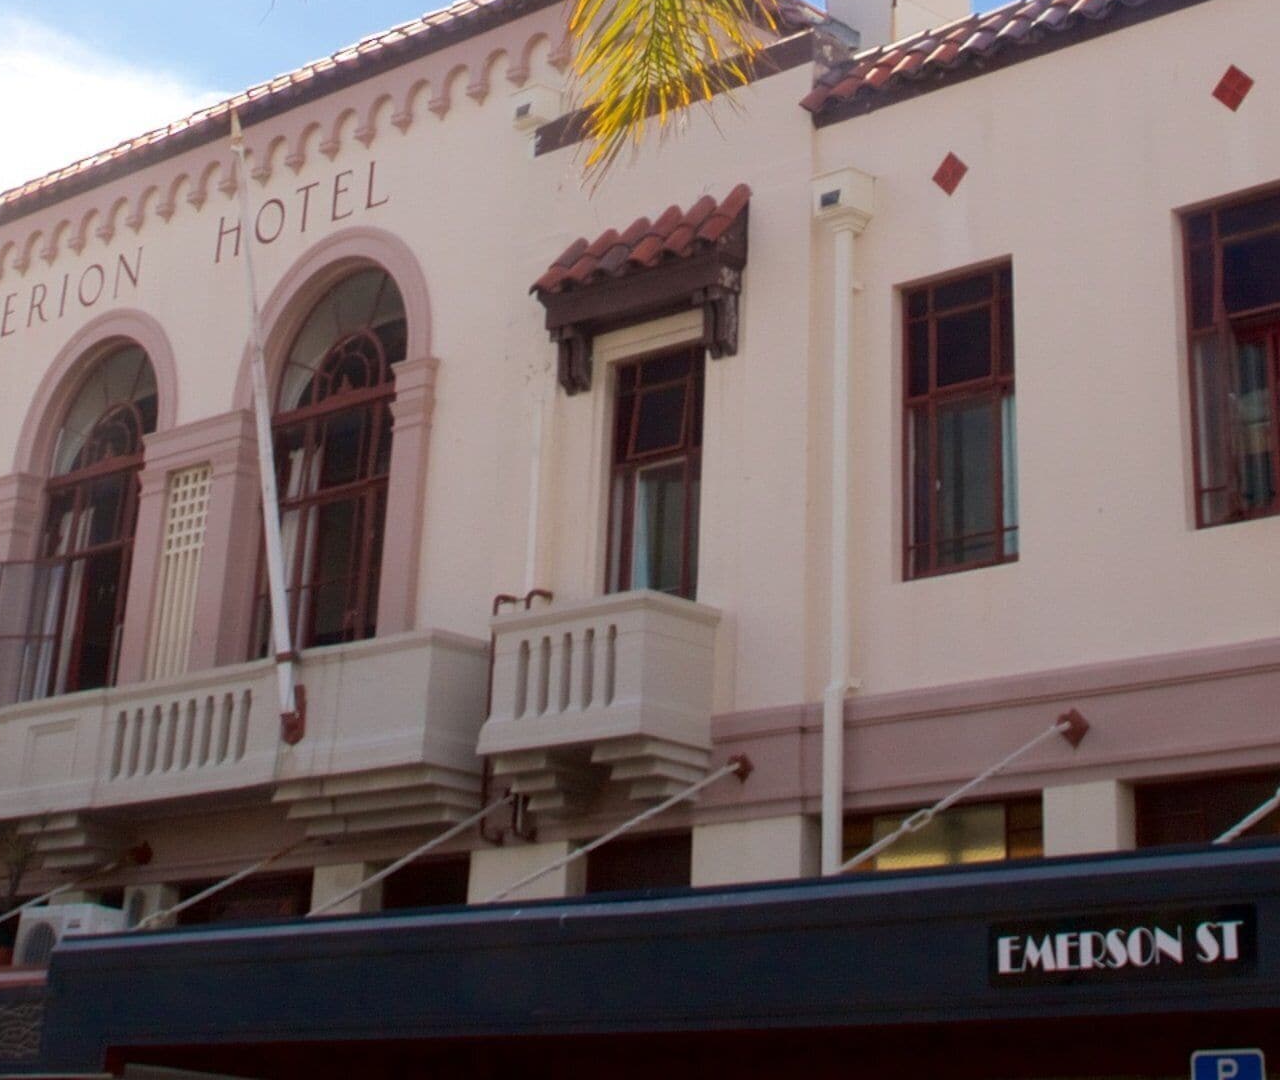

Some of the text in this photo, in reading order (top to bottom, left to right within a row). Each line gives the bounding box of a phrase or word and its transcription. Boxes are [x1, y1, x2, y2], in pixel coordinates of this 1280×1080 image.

[214, 160, 390, 264] HOTEL
[997, 920, 1245, 974] EMERSON ST
[1217, 1058, 1239, 1080] P
